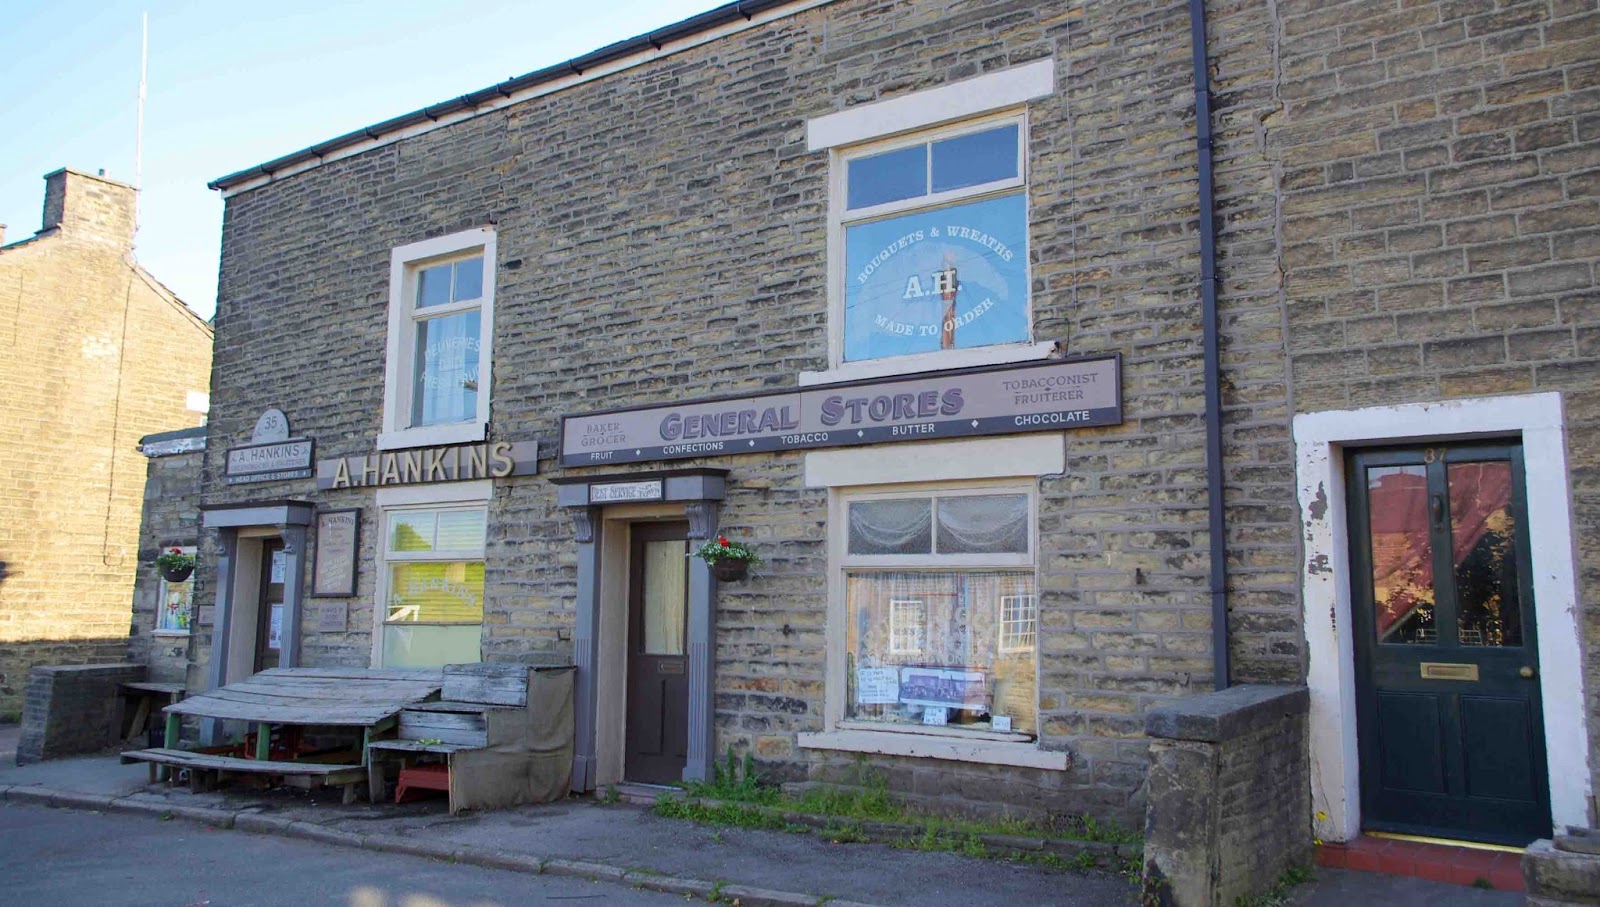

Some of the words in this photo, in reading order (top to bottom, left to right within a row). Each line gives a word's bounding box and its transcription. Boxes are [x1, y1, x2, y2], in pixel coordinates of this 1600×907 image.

[857, 229, 925, 285] BOUQUETS
[930, 227, 940, 238] &
[946, 225, 1014, 262] WREATHS
[874, 314, 915, 336] MADE
[919, 324, 938, 337] TO
[943, 297, 995, 333] ORDER
[1002, 373, 1099, 391] TOBACCONIST
[1014, 390, 1084, 405] FRUITERER
[264, 416, 278, 430] 35
[659, 405, 799, 441] GENERAL
[820, 388, 966, 426] STORES
[586, 422, 621, 435] BAKER
[590, 451, 614, 461] FRUIT
[662, 441, 725, 455] CONFECTIONS
[780, 432, 829, 445] TOBACCO
[892, 422, 936, 436] BUTTER
[1014, 411, 1091, 426] CHOCOLATE
[581, 434, 626, 447] GROCER
[251, 444, 300, 461] HANKINS
